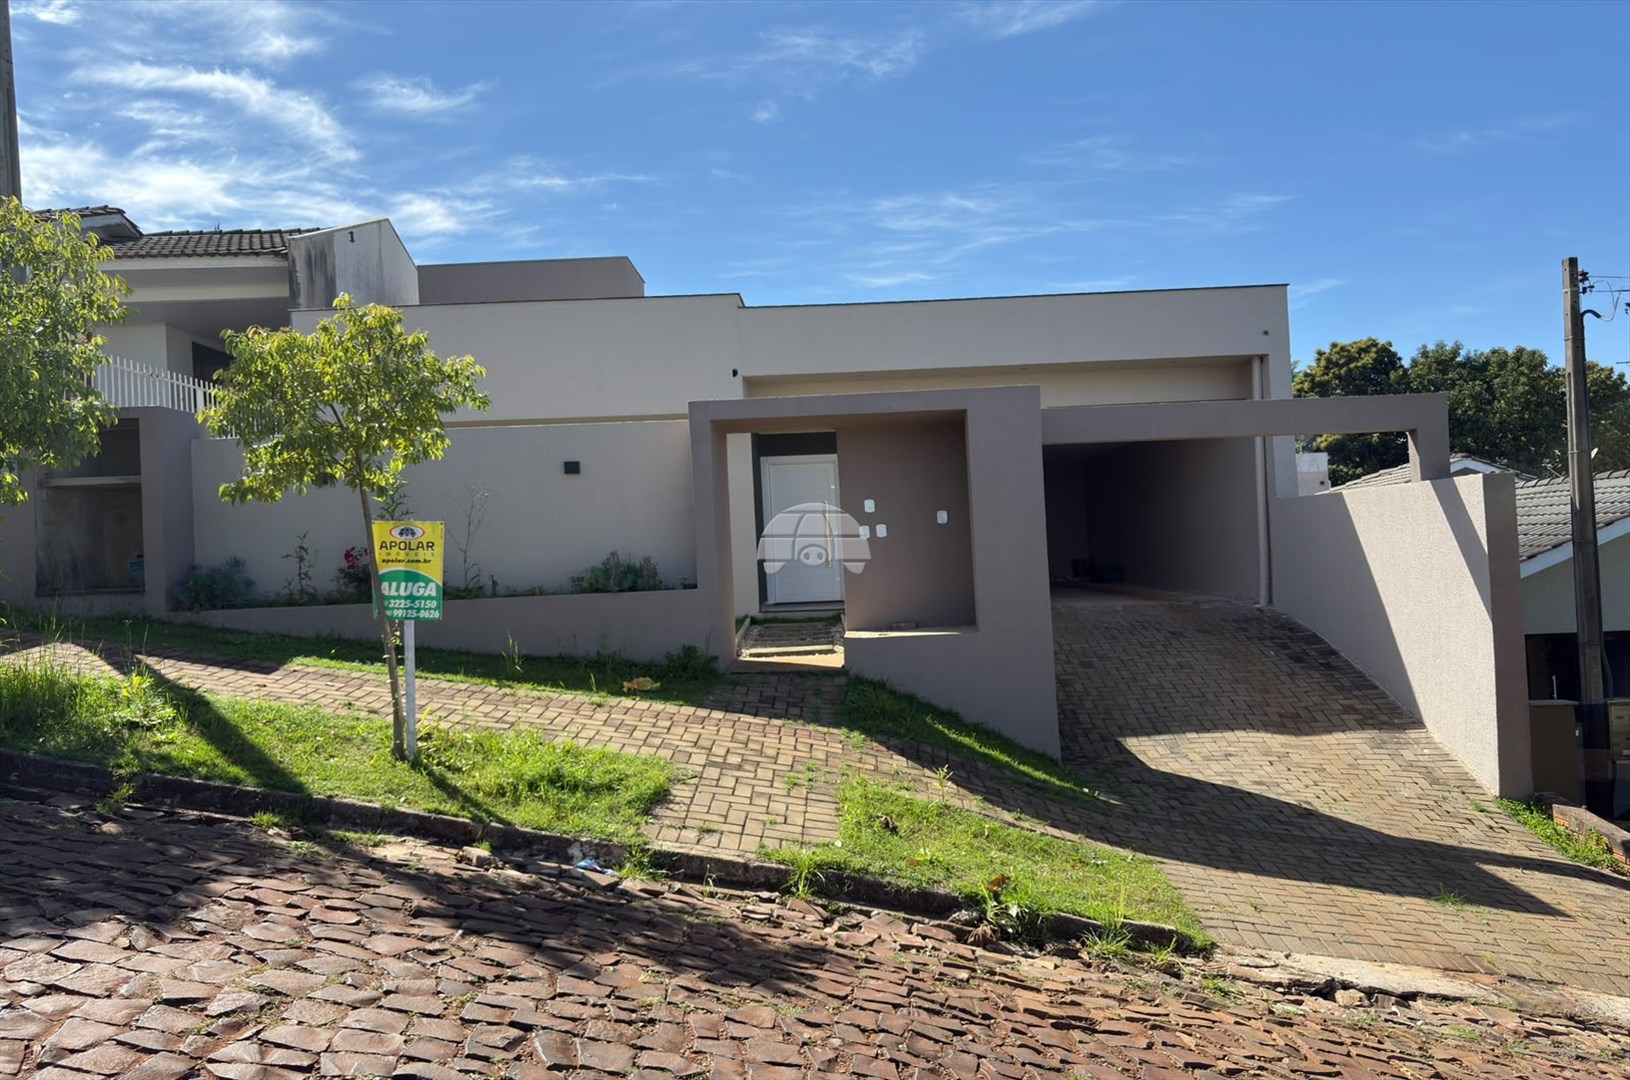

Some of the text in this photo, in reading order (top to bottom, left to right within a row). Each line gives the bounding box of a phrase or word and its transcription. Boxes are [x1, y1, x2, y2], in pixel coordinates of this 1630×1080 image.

[379, 541, 435, 551] APOLAR
[381, 581, 436, 596] ALUGA
[388, 599, 437, 608] 3225-5150
